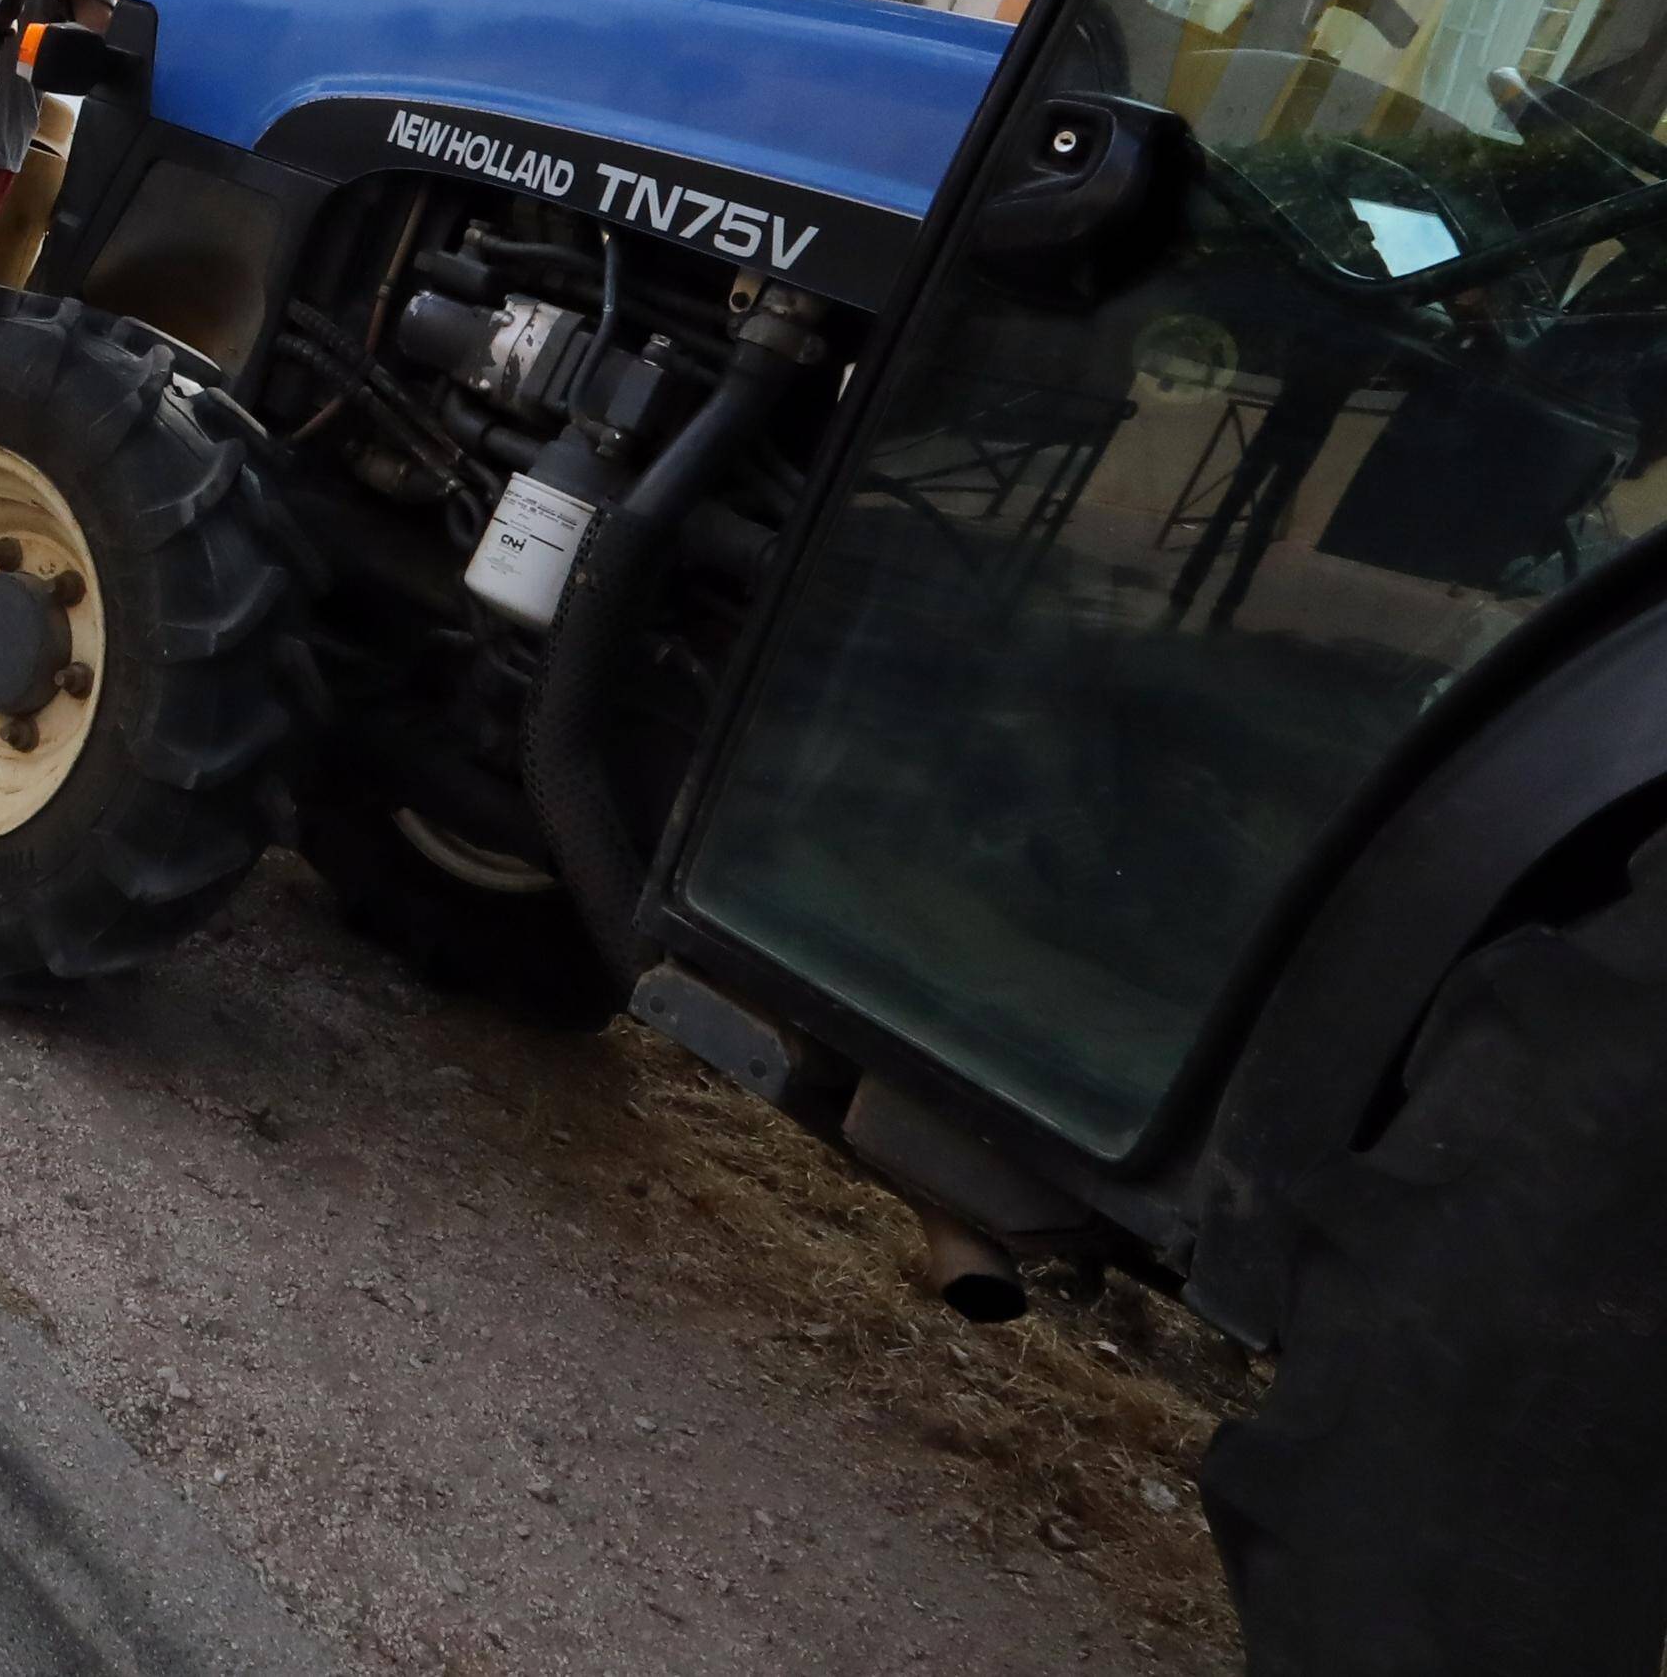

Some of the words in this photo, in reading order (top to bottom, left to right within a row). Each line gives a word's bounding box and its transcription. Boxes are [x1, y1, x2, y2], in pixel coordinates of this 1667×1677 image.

[386, 109, 450, 157] NEW
[444, 125, 575, 197] HOLLAND
[595, 162, 820, 270] TN75V
